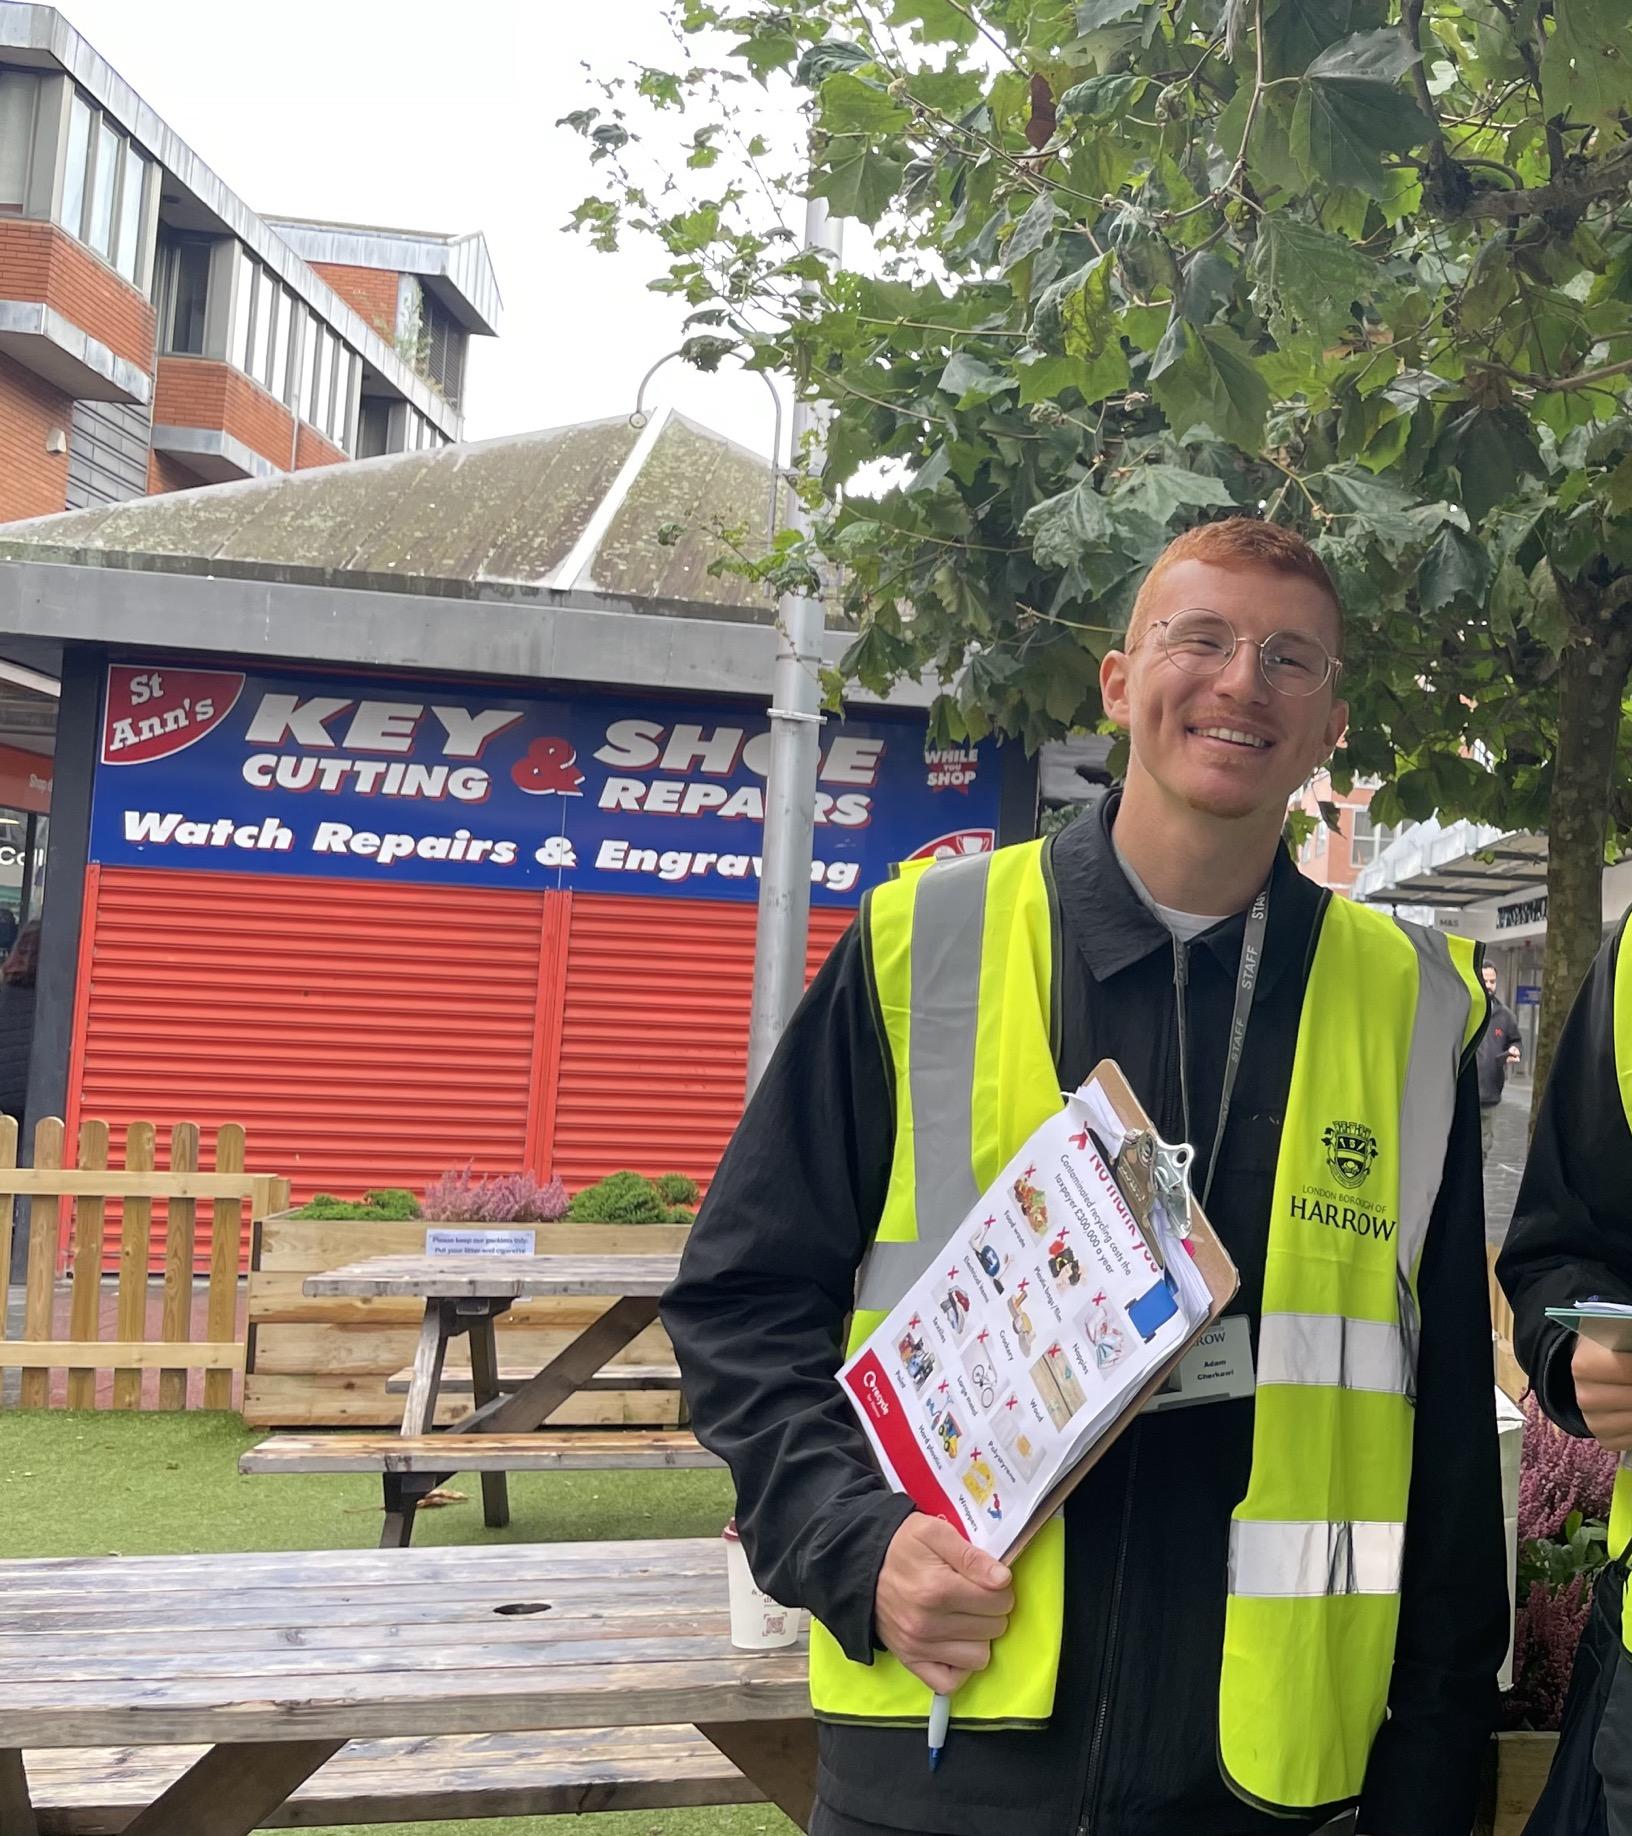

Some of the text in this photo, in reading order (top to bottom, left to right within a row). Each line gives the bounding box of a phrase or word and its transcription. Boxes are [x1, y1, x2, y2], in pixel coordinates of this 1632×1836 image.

[130, 671, 164, 706] St
[109, 697, 216, 752] Ann's
[245, 693, 524, 757] KEY
[511, 737, 586, 797] &
[925, 749, 979, 764] WHILE
[927, 771, 977, 786] SHOP
[242, 753, 872, 826] CUTTING REPARS
[124, 810, 293, 850] Watch
[313, 821, 517, 864] Repairs
[535, 836, 577, 868] &
[1241, 945, 1258, 990] STAFF
[1229, 1017, 1245, 1063] STAFF
[1060, 1154, 1132, 1276] Contaminated recycling costs the
[1290, 1195, 1398, 1242] HARROW
[1302, 1184, 1388, 1214] LONDON BOROUGH OF
[1054, 1173, 1076, 1210] taxpayer
[1074, 1207, 1101, 1248] £300,000
[1098, 1254, 1114, 1274] year
